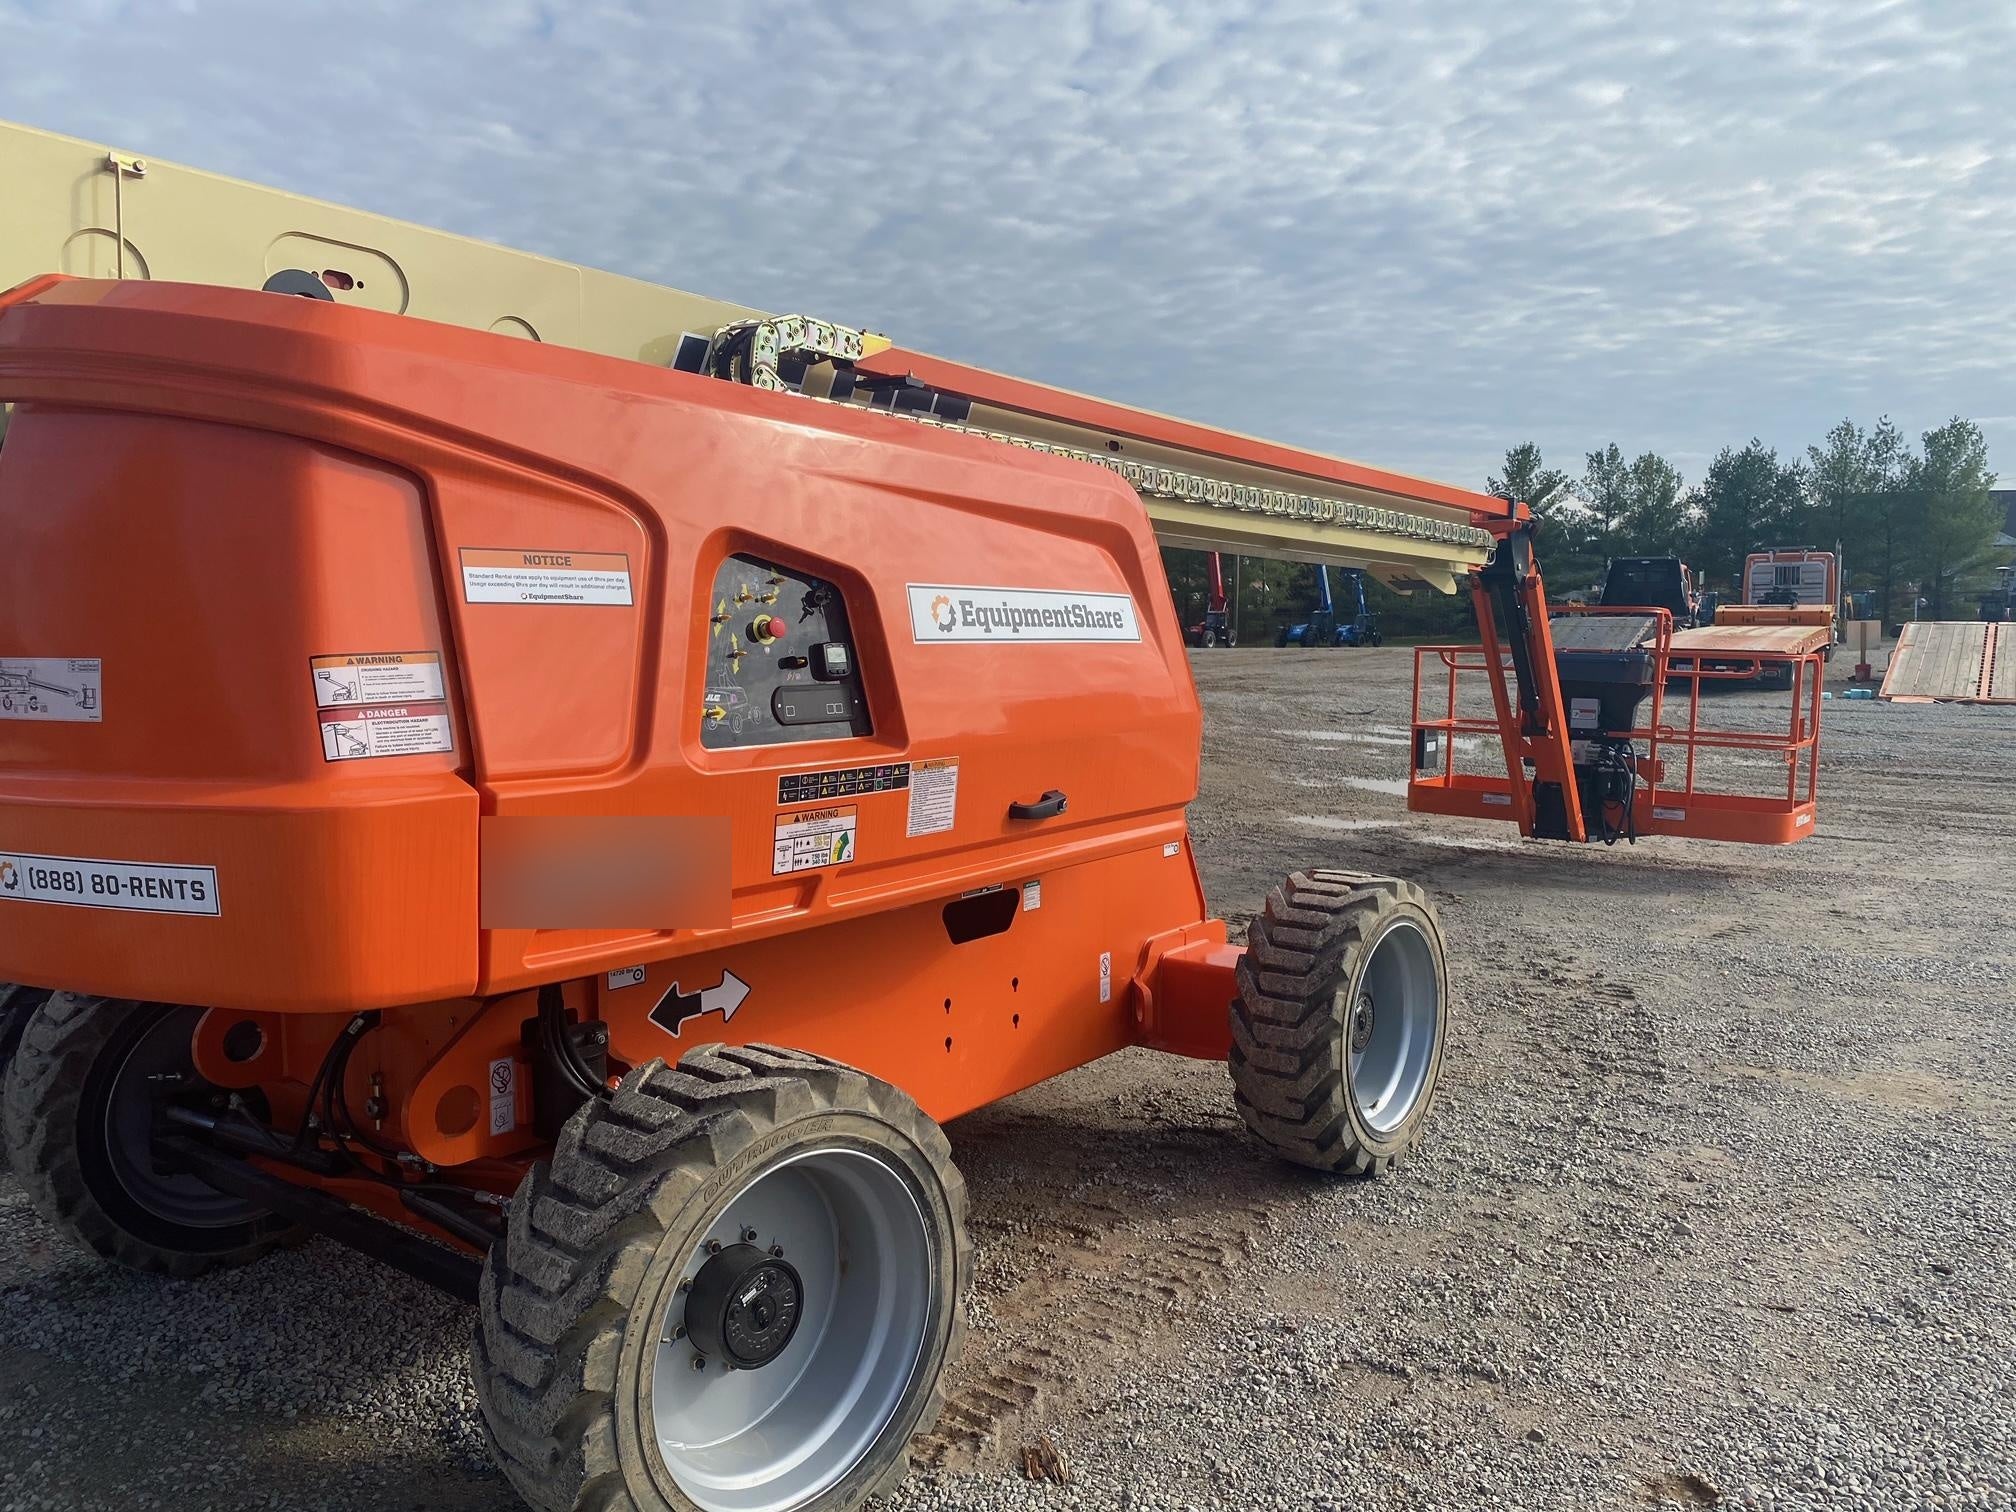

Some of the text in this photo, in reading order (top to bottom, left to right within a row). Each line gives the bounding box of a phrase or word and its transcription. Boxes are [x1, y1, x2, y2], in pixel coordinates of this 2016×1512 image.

[523, 554, 572, 566] NOTICE
[528, 593, 584, 601] EquipmentShare
[958, 600, 1124, 633] EquipmentShare
[356, 656, 403, 665] WARNING
[366, 709, 408, 718] DANGER
[802, 809, 839, 822] WARNING
[28, 867, 206, 901] (888) 80-RENTS
